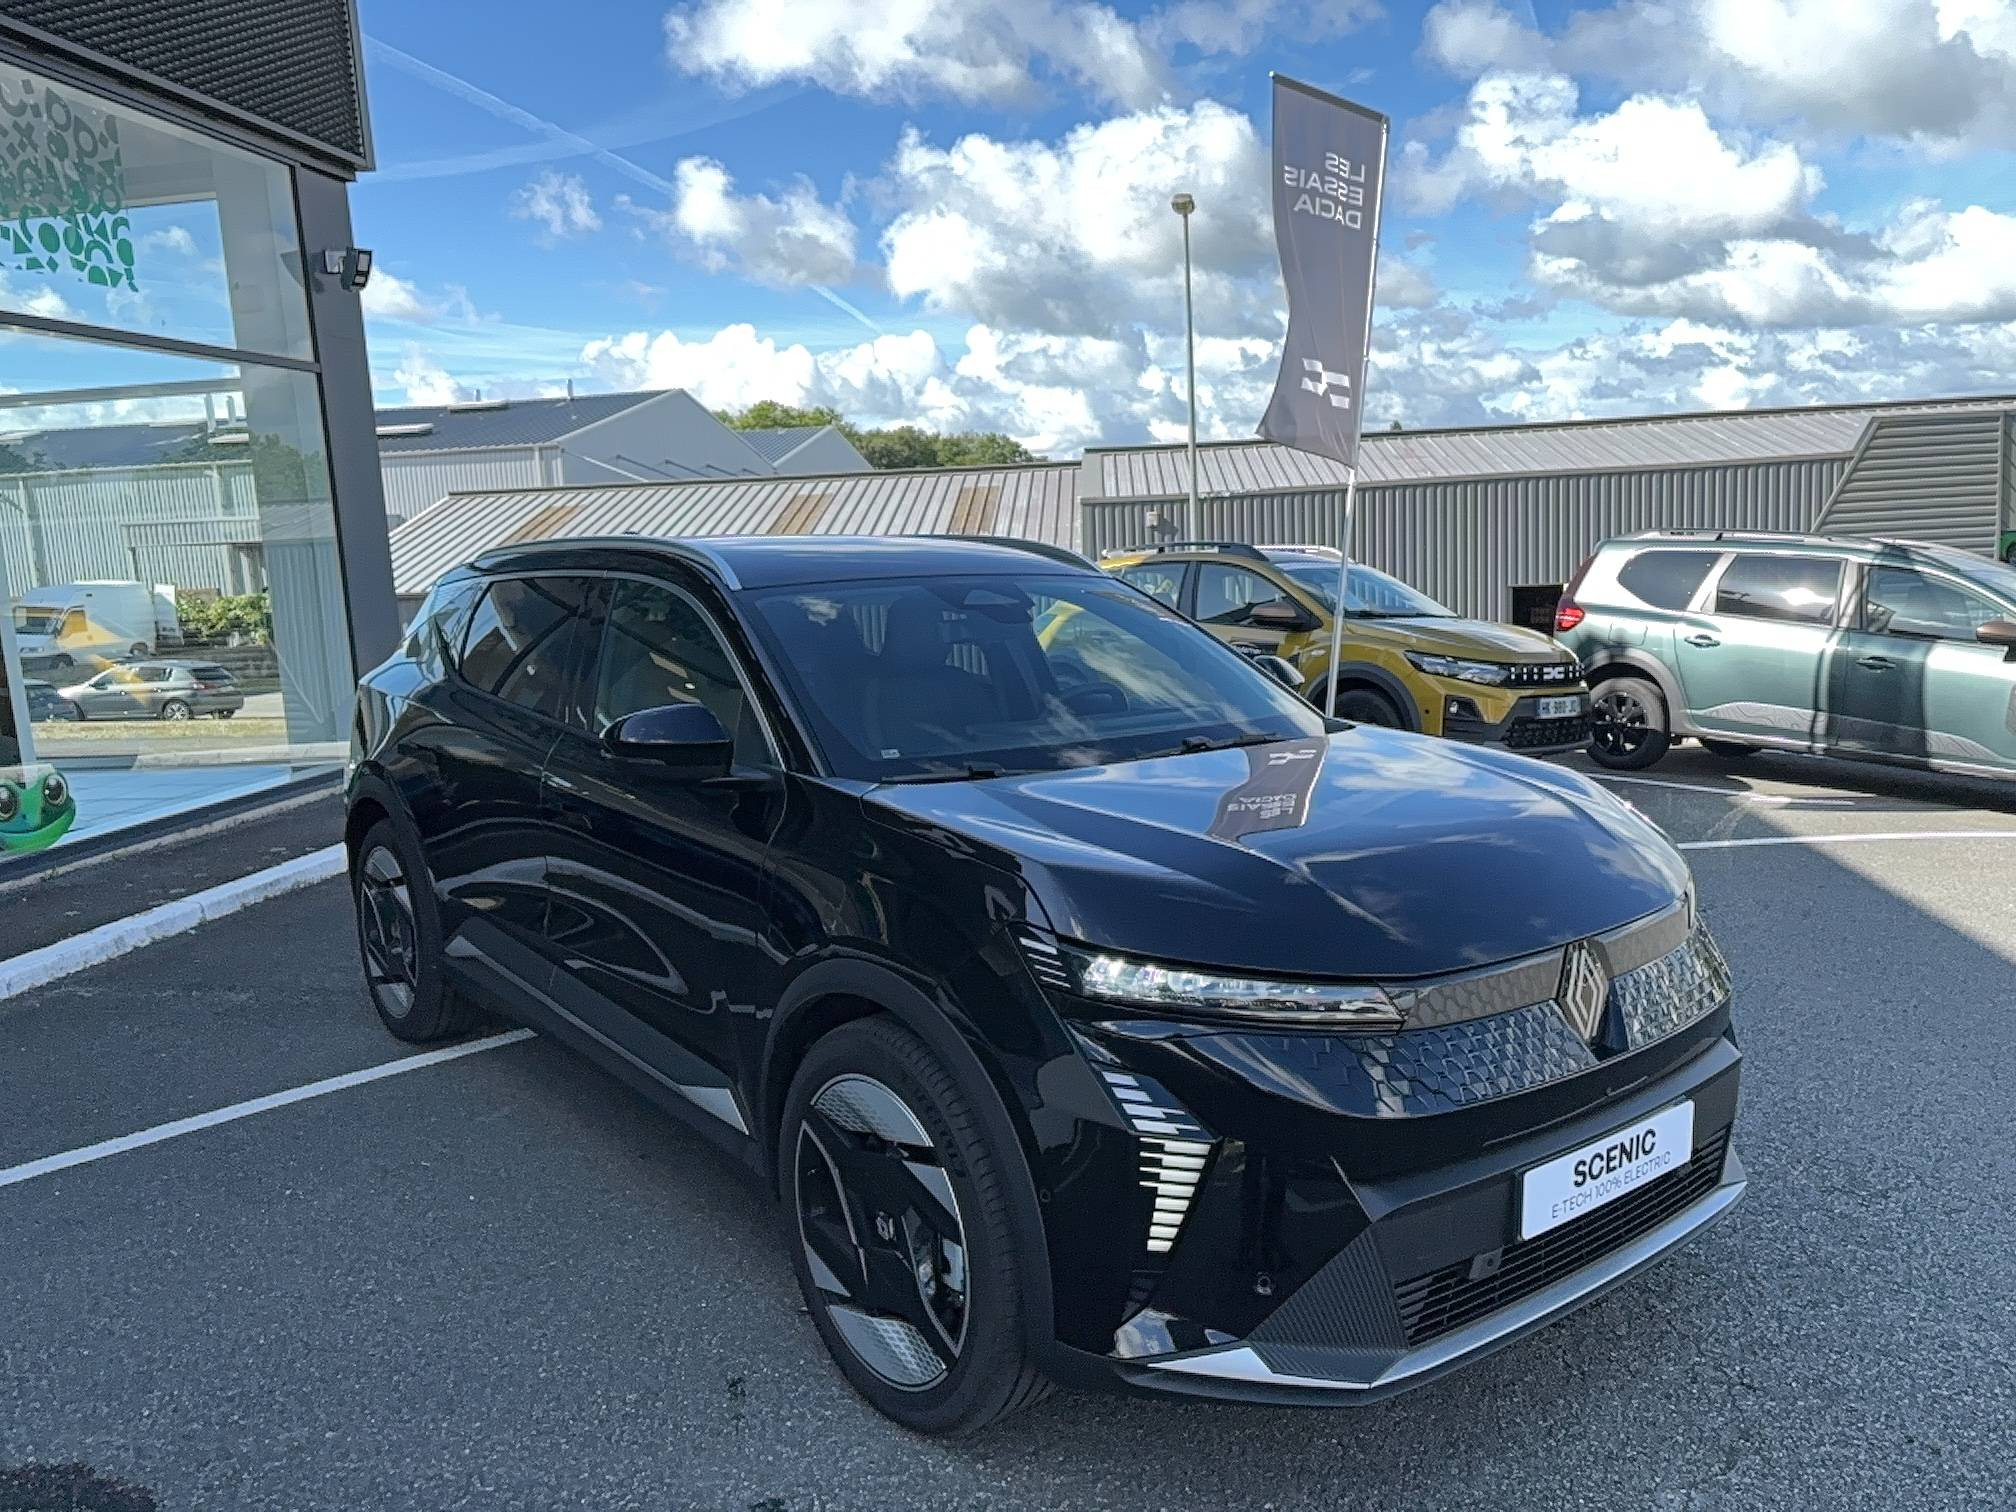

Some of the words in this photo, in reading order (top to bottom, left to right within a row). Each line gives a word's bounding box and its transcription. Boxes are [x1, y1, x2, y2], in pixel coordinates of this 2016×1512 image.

[1552, 1187, 1593, 1218] E-TECH
[1595, 1177, 1622, 1196] 100%
[1624, 1151, 1671, 1186] ELECTRIC
[1573, 1128, 1656, 1187] SCENIC
